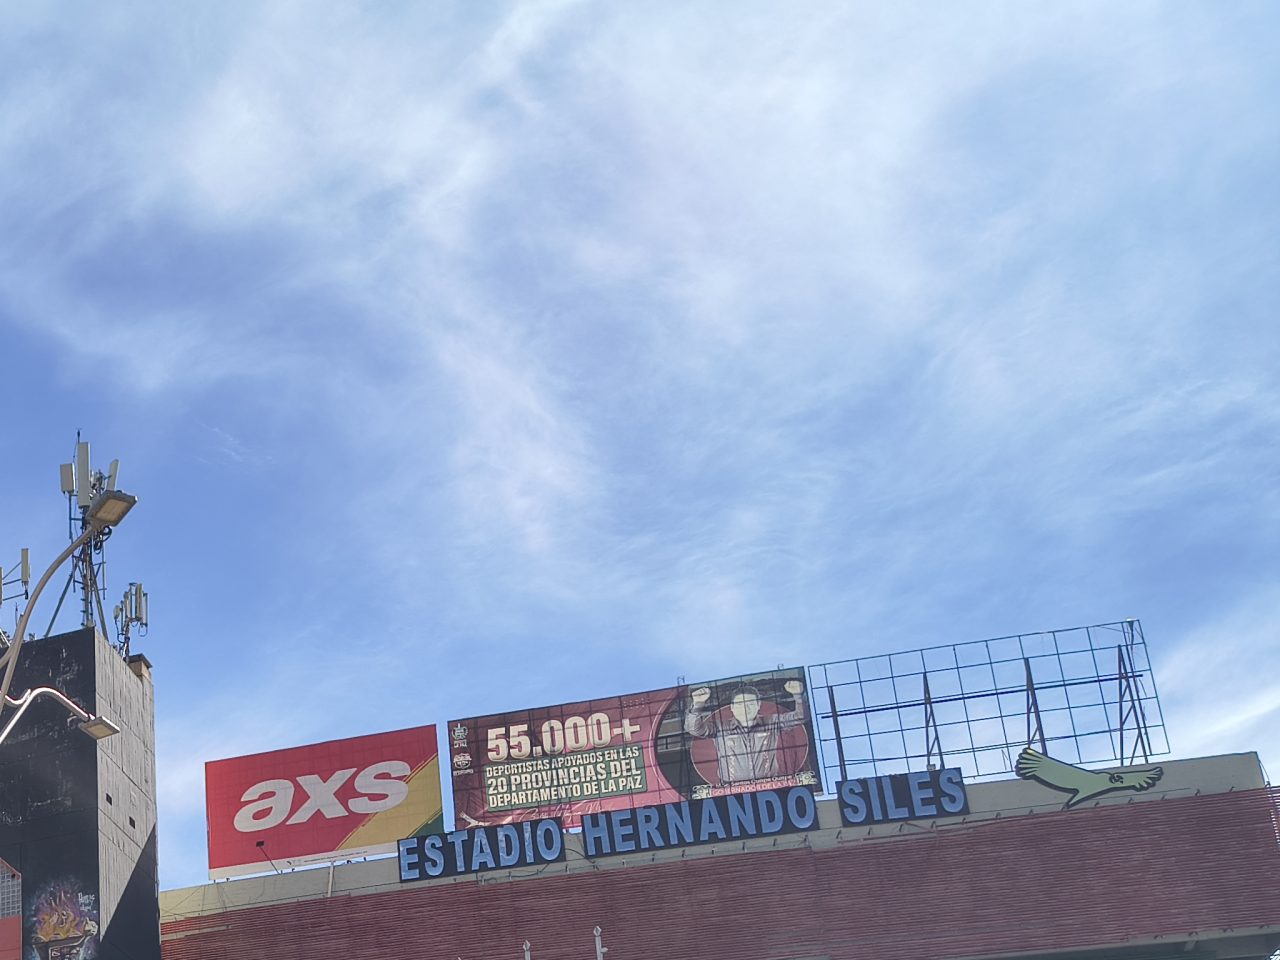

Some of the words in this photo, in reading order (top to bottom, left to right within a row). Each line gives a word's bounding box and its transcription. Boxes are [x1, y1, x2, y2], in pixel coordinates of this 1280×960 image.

[487, 712, 640, 762] 55.000+
[486, 759, 549, 778] DEPORTISTAS
[552, 751, 603, 769] APOYADOS
[605, 749, 617, 761] EN
[619, 746, 640, 759] LAS
[488, 777, 507, 794] 20
[511, 765, 607, 791] PROVINCIAS
[610, 758, 640, 778] DEL
[233, 761, 412, 832] axs
[488, 784, 581, 808] DEPARTAMENTO
[583, 782, 599, 796] DE
[601, 778, 617, 793] LA
[619, 775, 643, 791] PAZ
[399, 819, 562, 880] ESTADIO
[582, 788, 815, 856] HERNANDO
[841, 769, 964, 823] SILES
